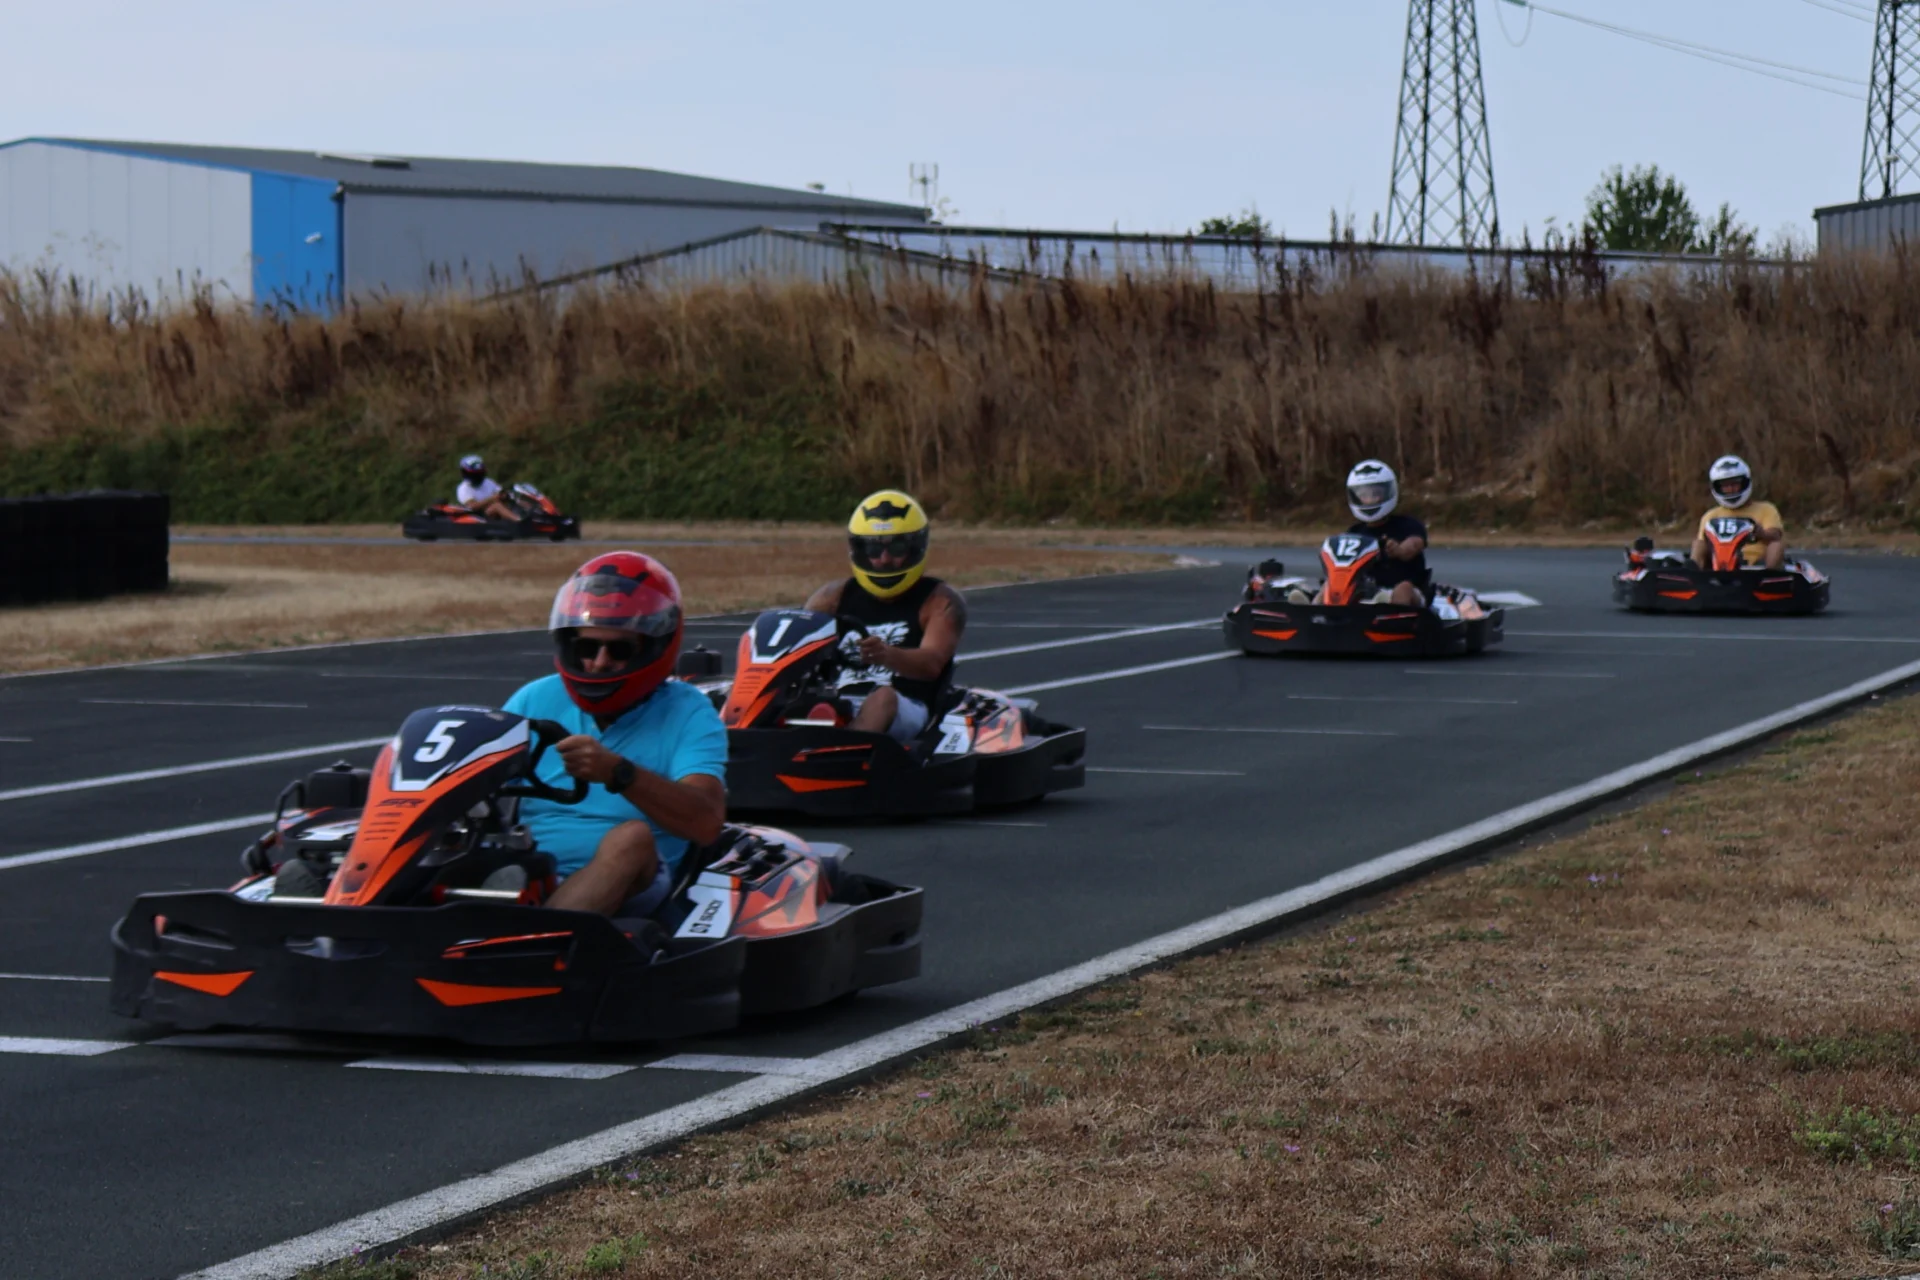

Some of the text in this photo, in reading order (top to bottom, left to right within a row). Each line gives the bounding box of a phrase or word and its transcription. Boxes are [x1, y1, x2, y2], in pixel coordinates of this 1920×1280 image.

[1718, 519, 1738, 534] 15
[1336, 538, 1361, 557] 12
[767, 618, 793, 647] 1
[413, 719, 467, 763] 5
